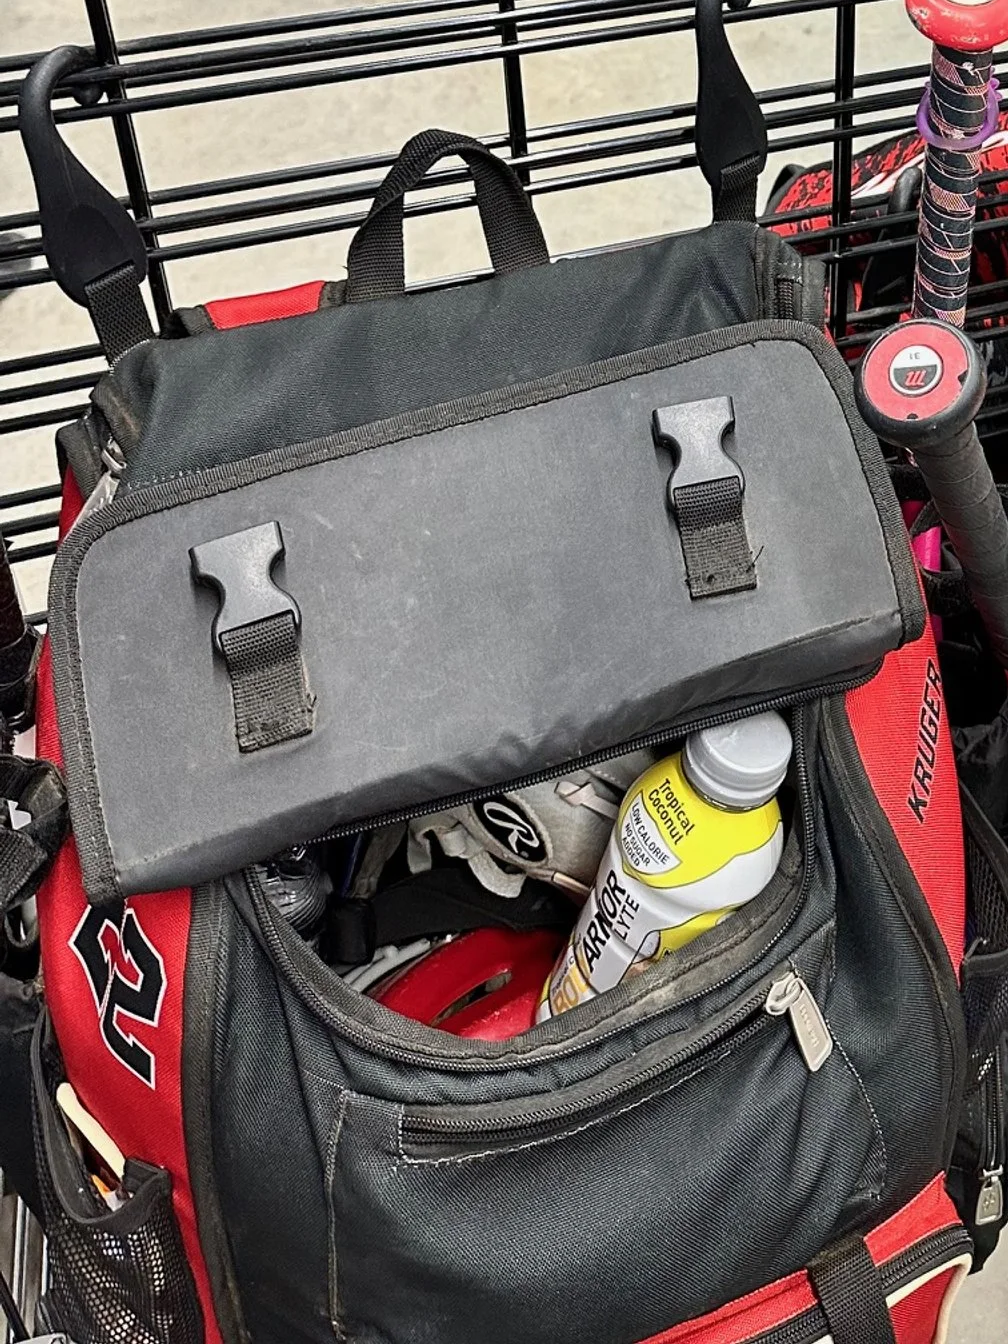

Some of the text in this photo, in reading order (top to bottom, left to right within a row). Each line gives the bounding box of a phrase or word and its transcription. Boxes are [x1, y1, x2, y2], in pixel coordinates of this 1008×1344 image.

[907, 657, 943, 825] KRUGER
[631, 802, 670, 866] LOW CALORIE
[648, 789, 685, 846] Coconut
[659, 778, 695, 836] Tropical
[629, 834, 651, 867] SUGAR
[614, 894, 640, 941] LYTE
